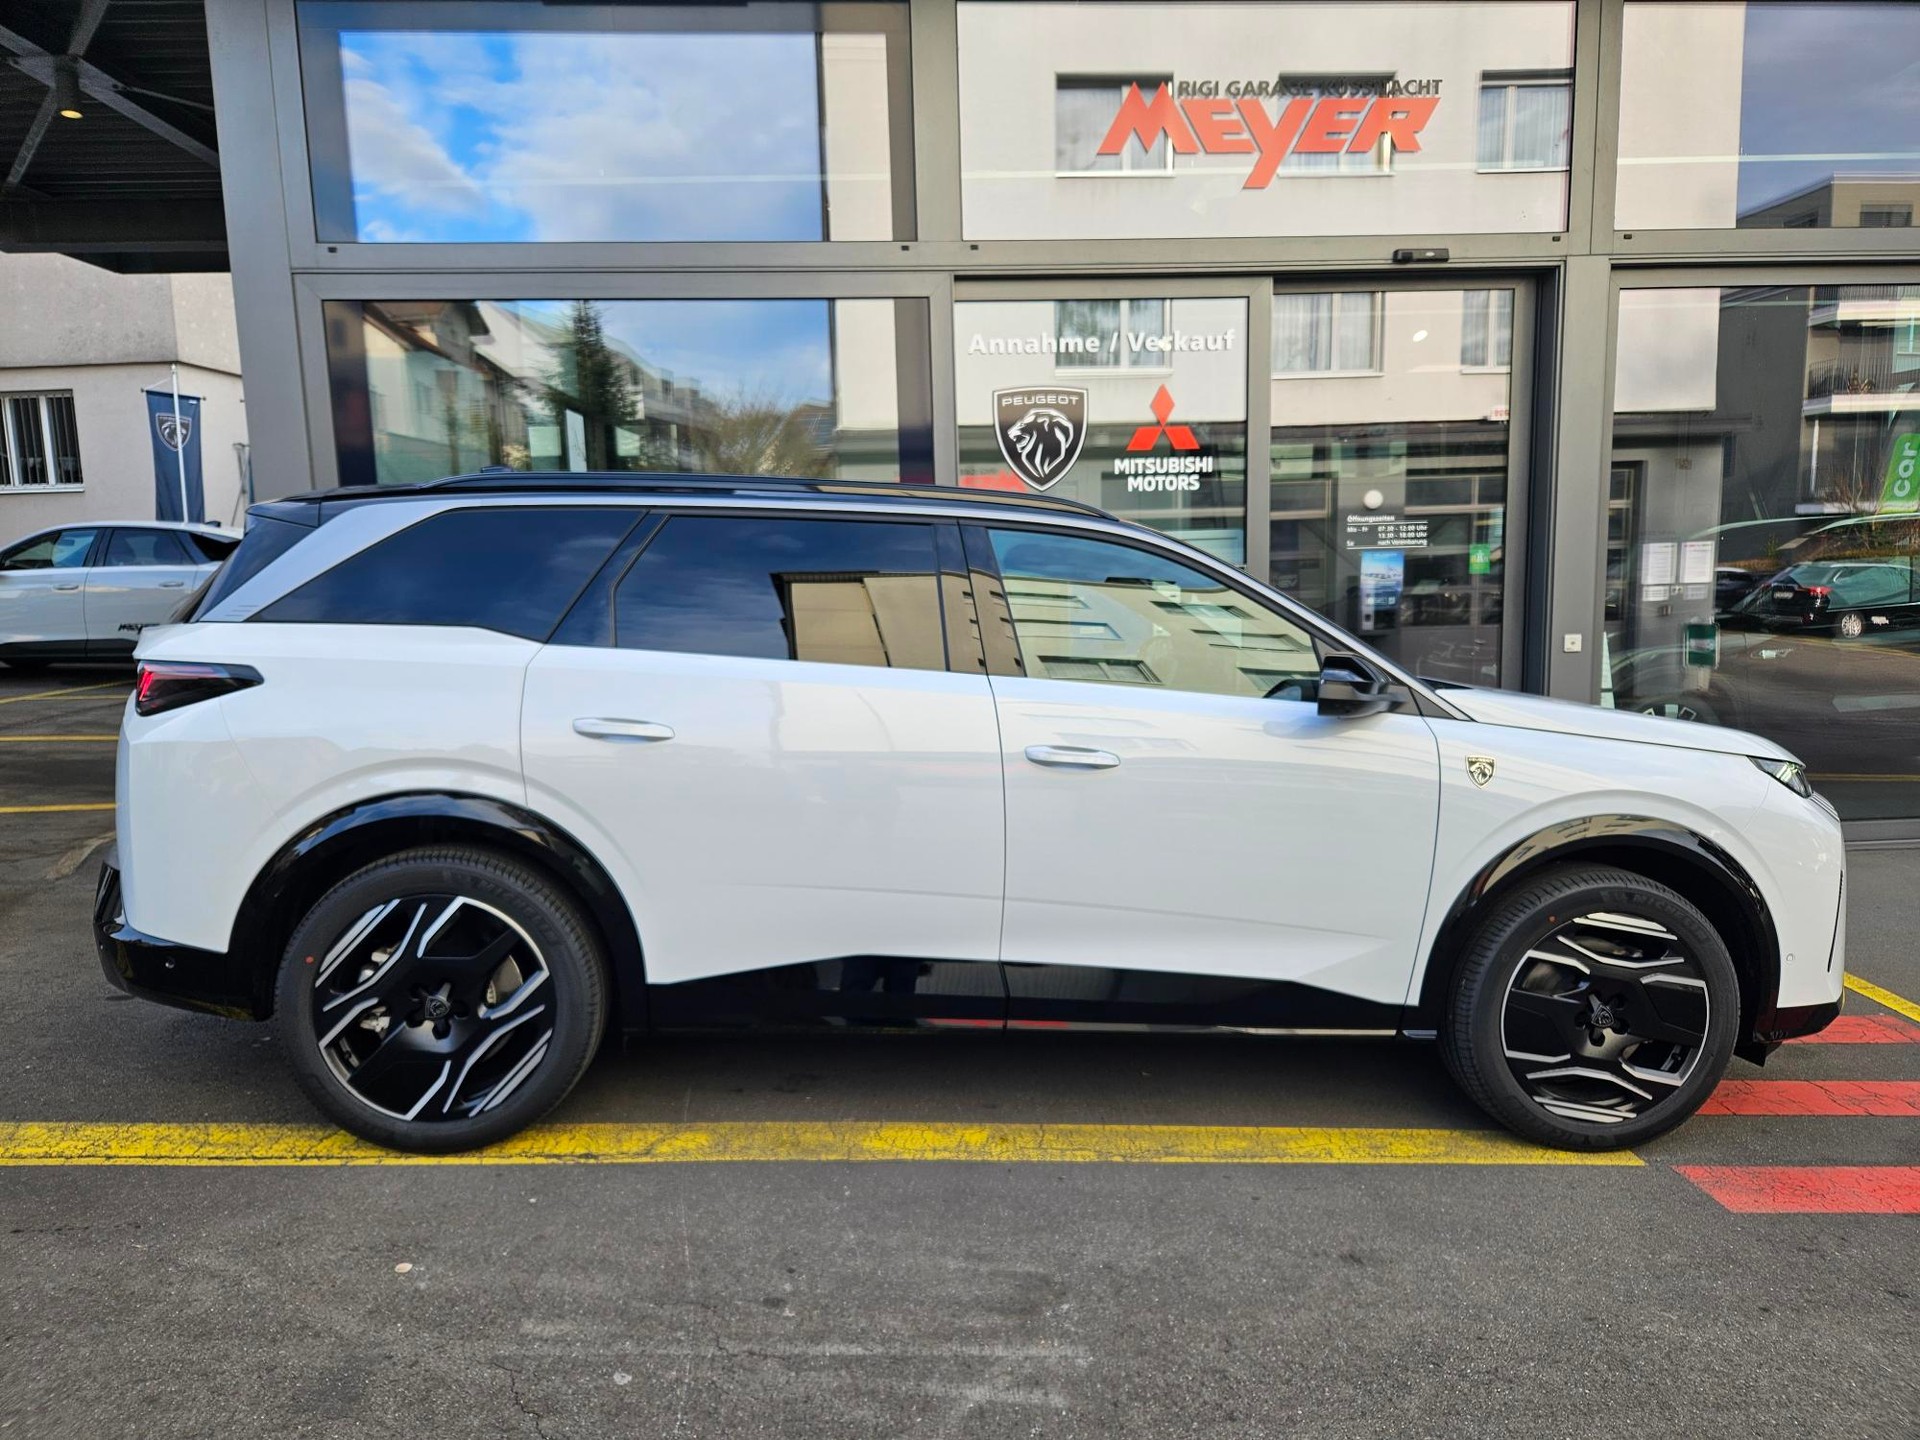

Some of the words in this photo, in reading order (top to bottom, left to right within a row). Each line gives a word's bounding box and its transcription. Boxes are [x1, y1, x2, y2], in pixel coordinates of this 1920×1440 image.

[1178, 80, 1219, 97] RIGI
[1227, 79, 1313, 97] GARAGE
[1096, 81, 1441, 189] MEYER
[967, 332, 1100, 354] Annahme
[1109, 332, 1119, 353] /
[1127, 329, 1235, 352] Verkauf
[1002, 395, 1079, 407] PEUGEOT
[1114, 456, 1213, 475] MITSUBISHI
[1893, 442, 1918, 497] car
[1127, 474, 1200, 492] MOTORS
